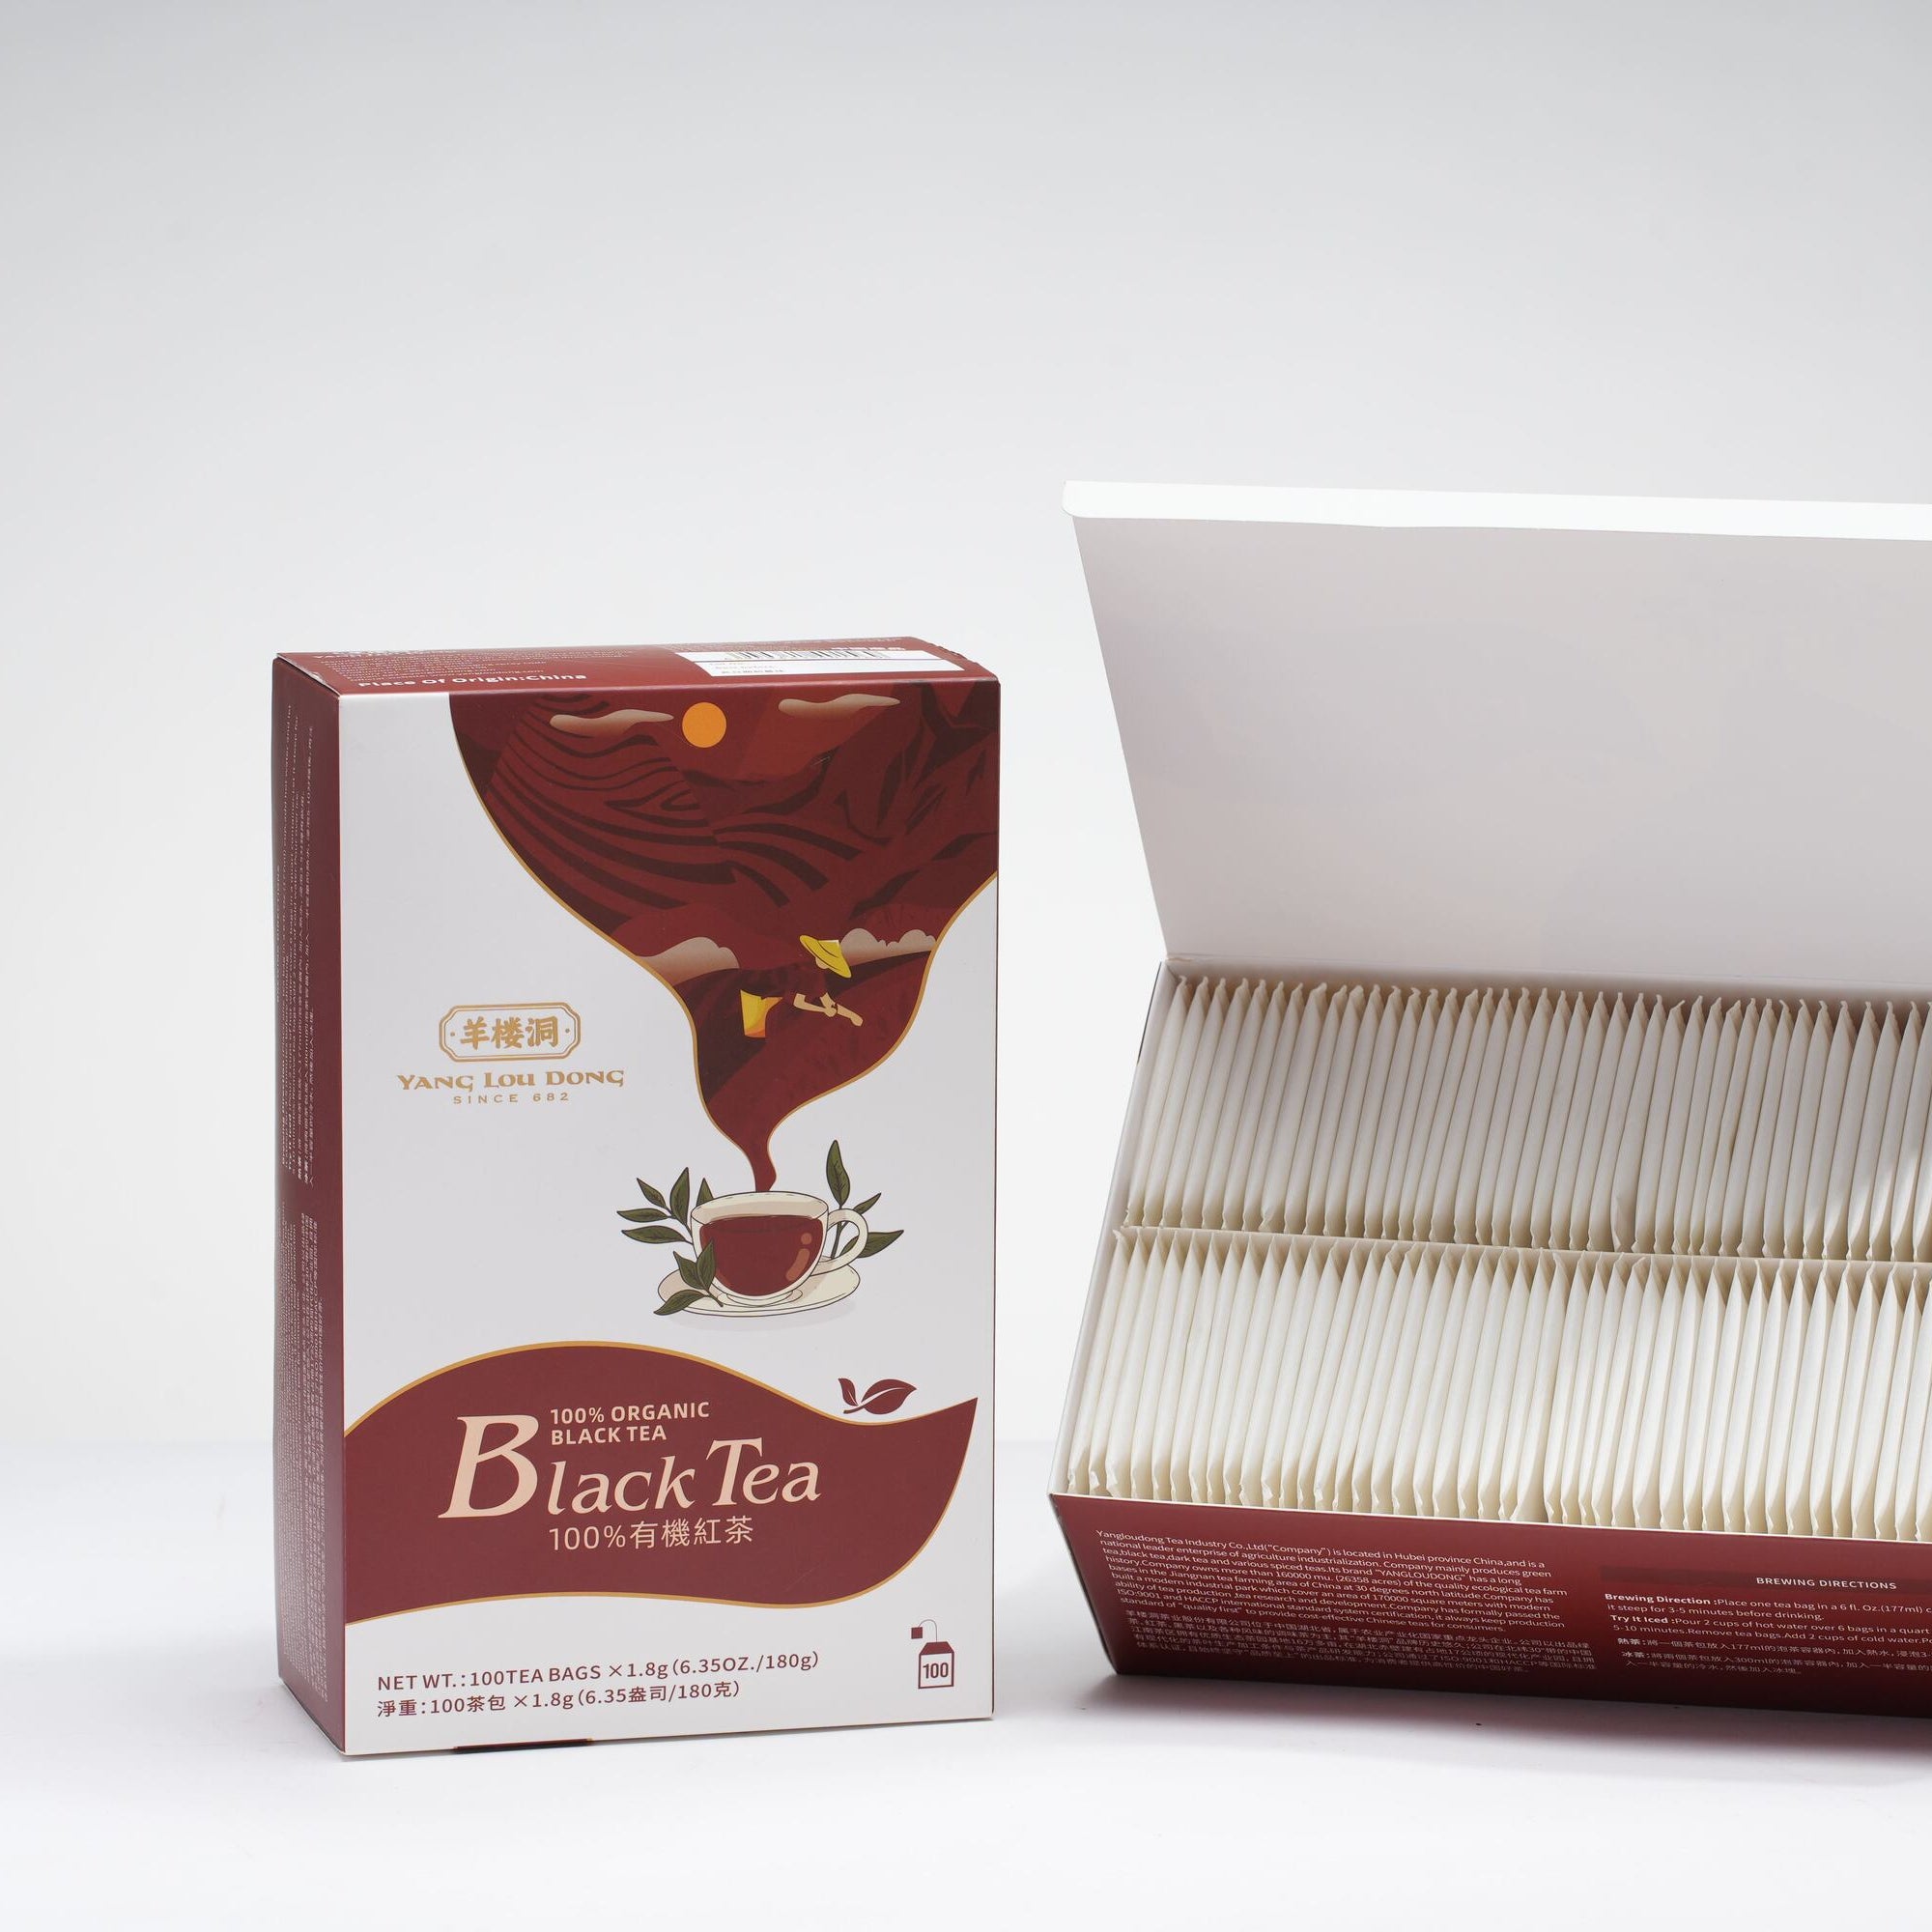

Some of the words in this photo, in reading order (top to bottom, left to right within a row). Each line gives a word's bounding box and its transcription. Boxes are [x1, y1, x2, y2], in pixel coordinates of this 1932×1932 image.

[397, 1074, 473, 1093] YANG
[545, 1069, 625, 1088] DONG
[453, 1094, 519, 1105] SINCE
[532, 1092, 569, 1102] 682
[550, 1406, 605, 1425] 100%
[611, 1401, 710, 1422] ORGANIC
[551, 1426, 621, 1446] BLACK
[627, 1424, 668, 1442] TEA
[438, 1414, 696, 1519] Black
[705, 1436, 822, 1507] Tea
[1096, 1530, 1165, 1544] Yangloudong
[1185, 1539, 1227, 1549] Industry
[1342, 1549, 1381, 1558] located
[1394, 1553, 1425, 1561] Hubei
[1100, 1540, 1141, 1549] national
[1142, 1543, 1174, 1552] leader
[1176, 1548, 1227, 1557] enterprise
[1241, 1553, 1296, 1561] agriculture
[1383, 1561, 1433, 1572] Company
[1435, 1565, 1470, 1574] mainly
[1472, 1567, 1520, 1576] produces
[1276, 1571, 1312, 1579] 160000
[1434, 1583, 1470, 1592] quality
[1471, 1584, 1523, 1594] ecological
[1543, 1588, 1567, 1596] farm
[1342, 1567, 1373, 1575] brand
[1497, 1577, 1522, 1586] long
[1756, 1577, 1815, 1586] BREWING
[1819, 1580, 1897, 1589] DIRECTIONS
[1605, 1593, 1654, 1603] Brewing
[1656, 1596, 1711, 1604] Direction
[1793, 1602, 1816, 1610] bag
[1617, 1605, 1648, 1613] steep
[1610, 1615, 1629, 1623] Try
[1847, 1625, 1874, 1633] bags
[378, 1675, 418, 1691] NET
[549, 1664, 601, 1682] BAGS
[922, 1662, 950, 1679] 100
